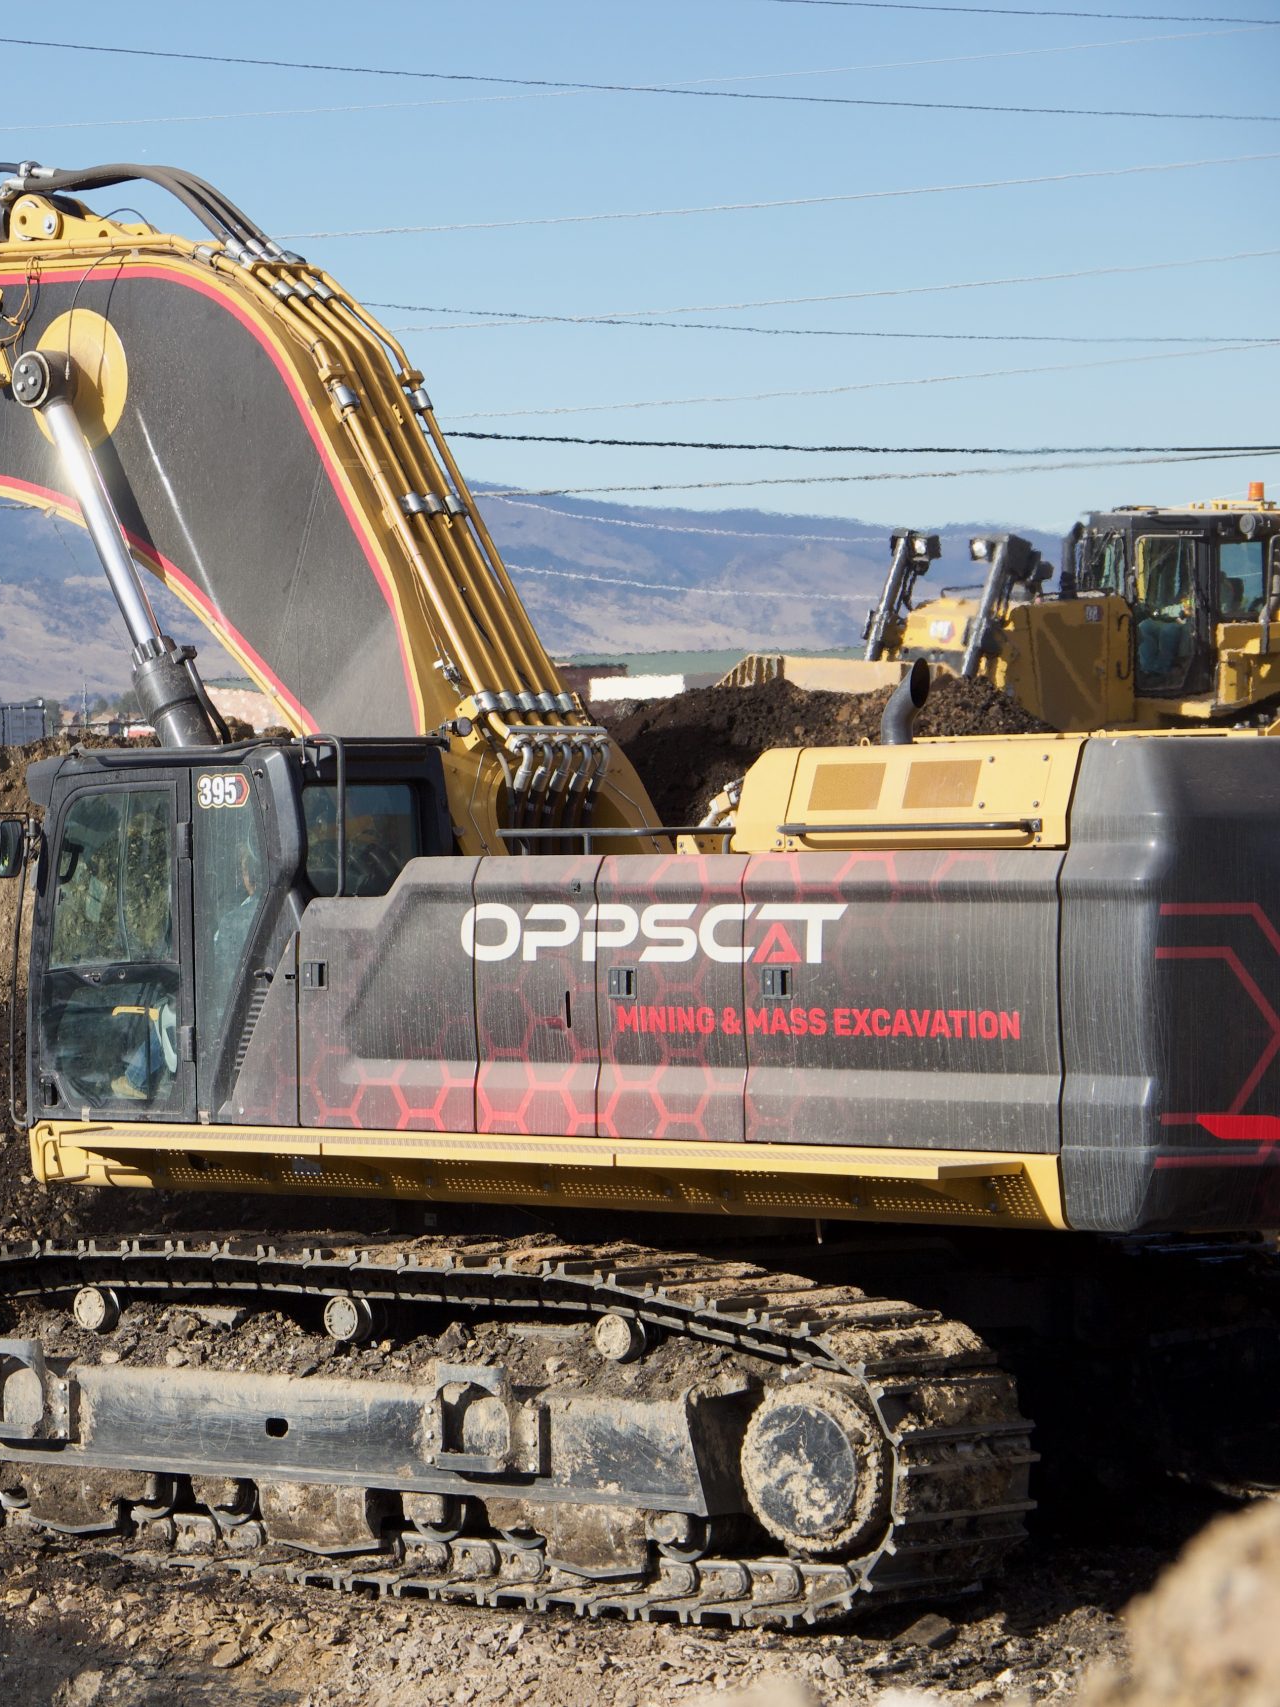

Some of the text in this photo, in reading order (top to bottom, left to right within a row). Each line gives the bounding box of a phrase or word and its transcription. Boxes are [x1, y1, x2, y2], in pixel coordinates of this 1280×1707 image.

[199, 776, 237, 805] 395
[460, 902, 849, 964] OPPSCAT
[616, 1005, 1021, 1041] MINING & MASS EXCAVATION
